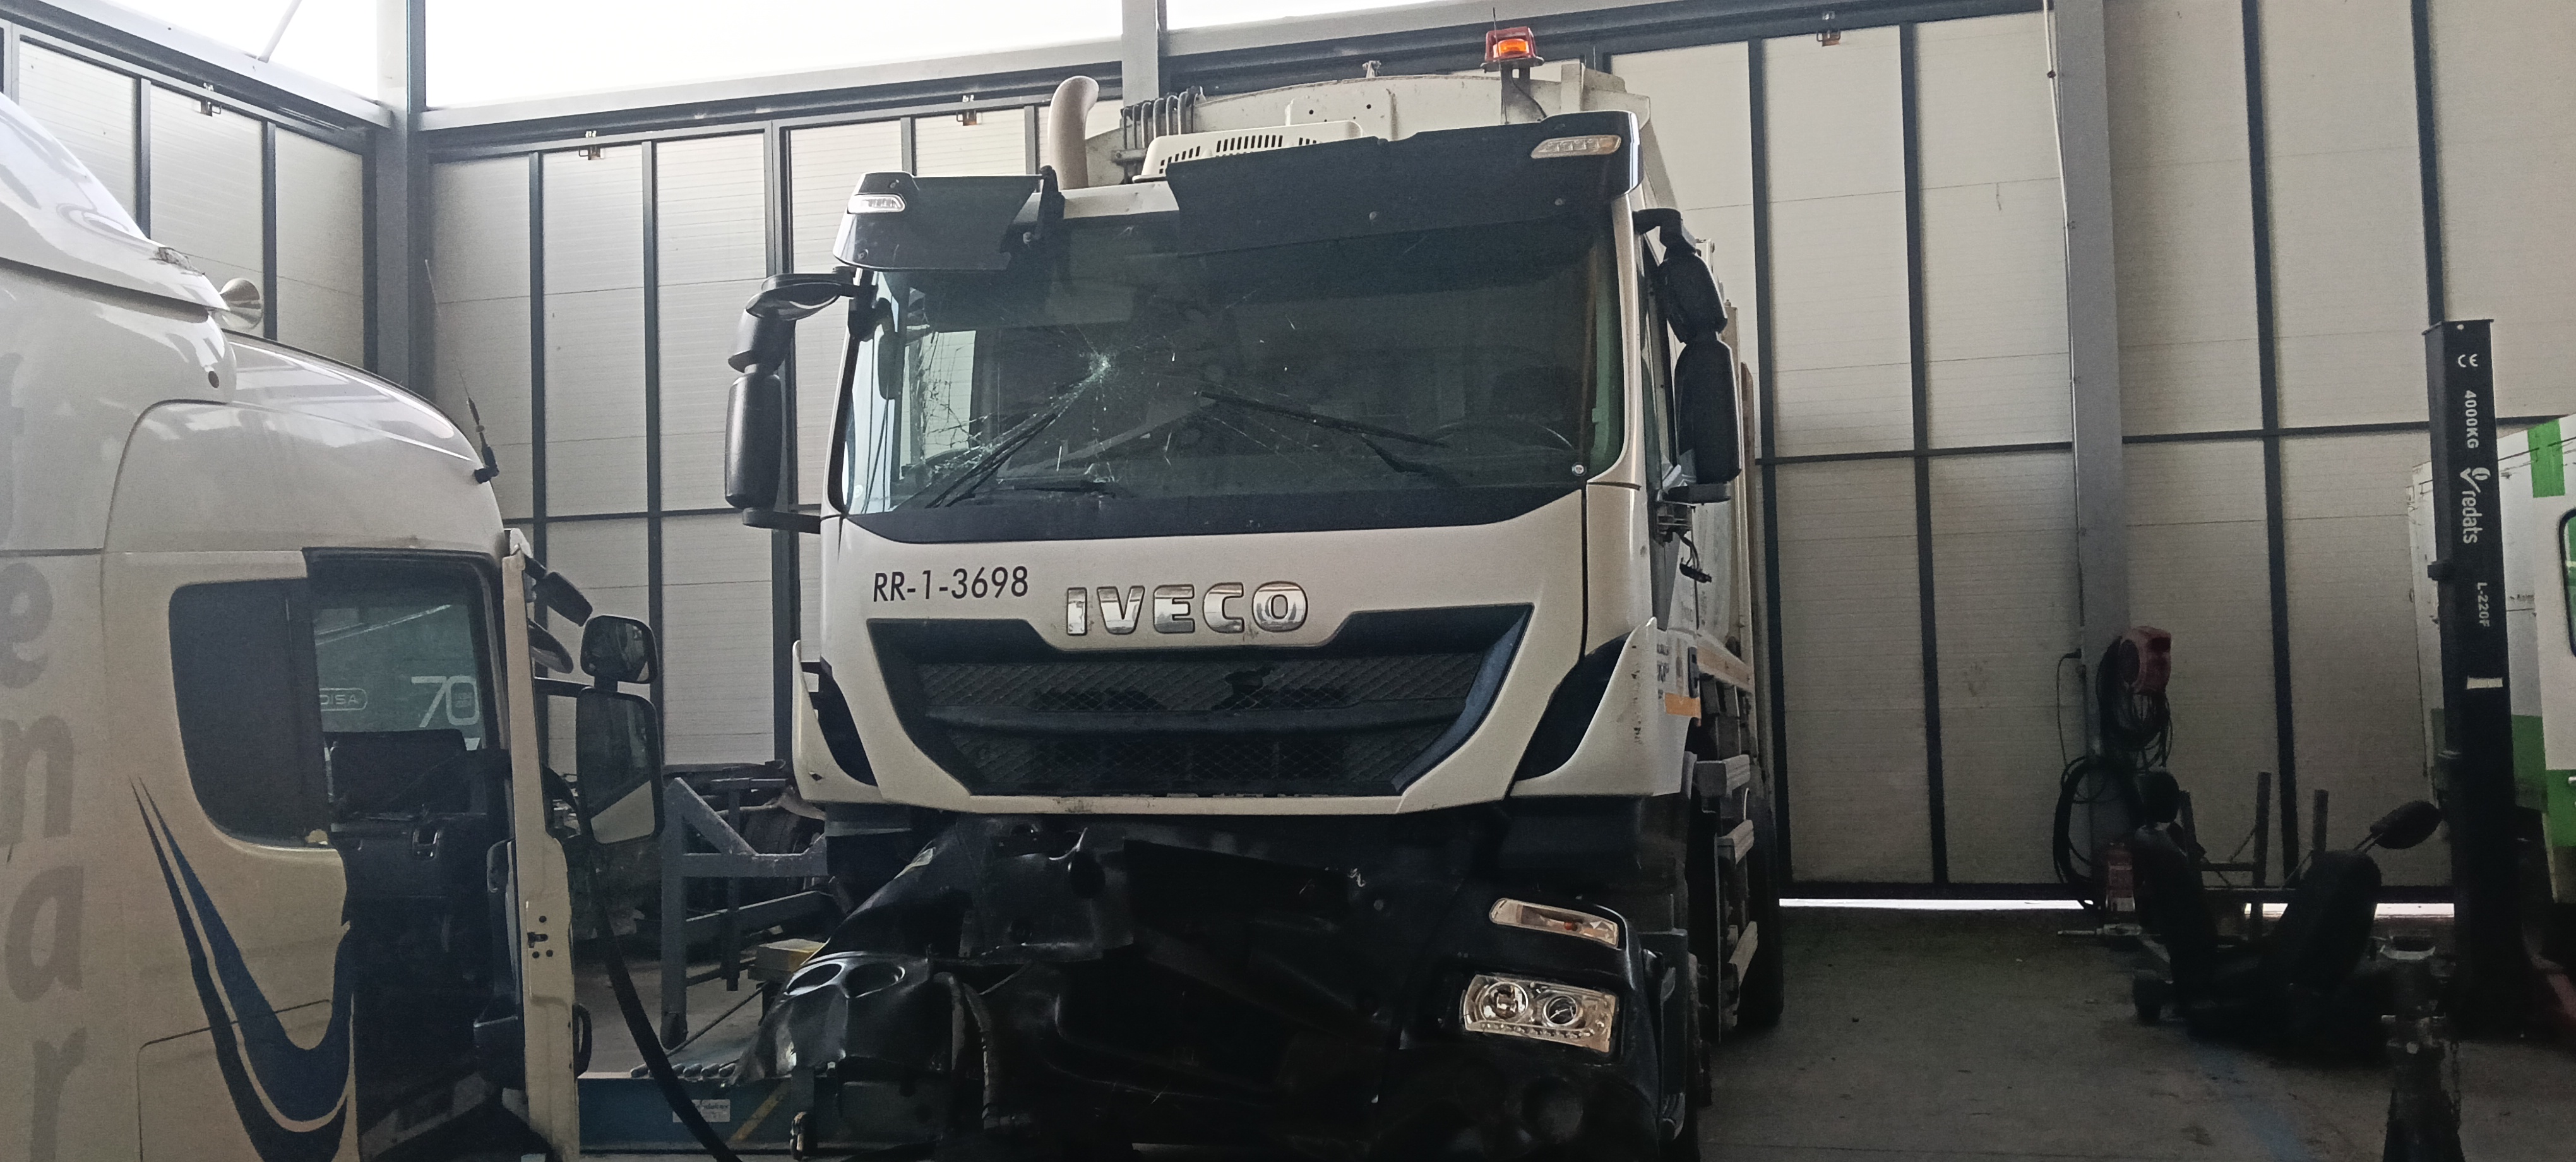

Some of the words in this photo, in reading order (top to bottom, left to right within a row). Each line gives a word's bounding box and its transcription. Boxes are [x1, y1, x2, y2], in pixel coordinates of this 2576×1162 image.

[2457, 352, 2479, 368] CE
[2464, 389, 2479, 449] 4000KG
[2462, 491, 2483, 544] redats
[873, 565, 1029, 602] RR-1-3698
[1066, 580, 1309, 636] IVECO
[2476, 582, 2490, 627] L-220F
[410, 675, 480, 728] 70
